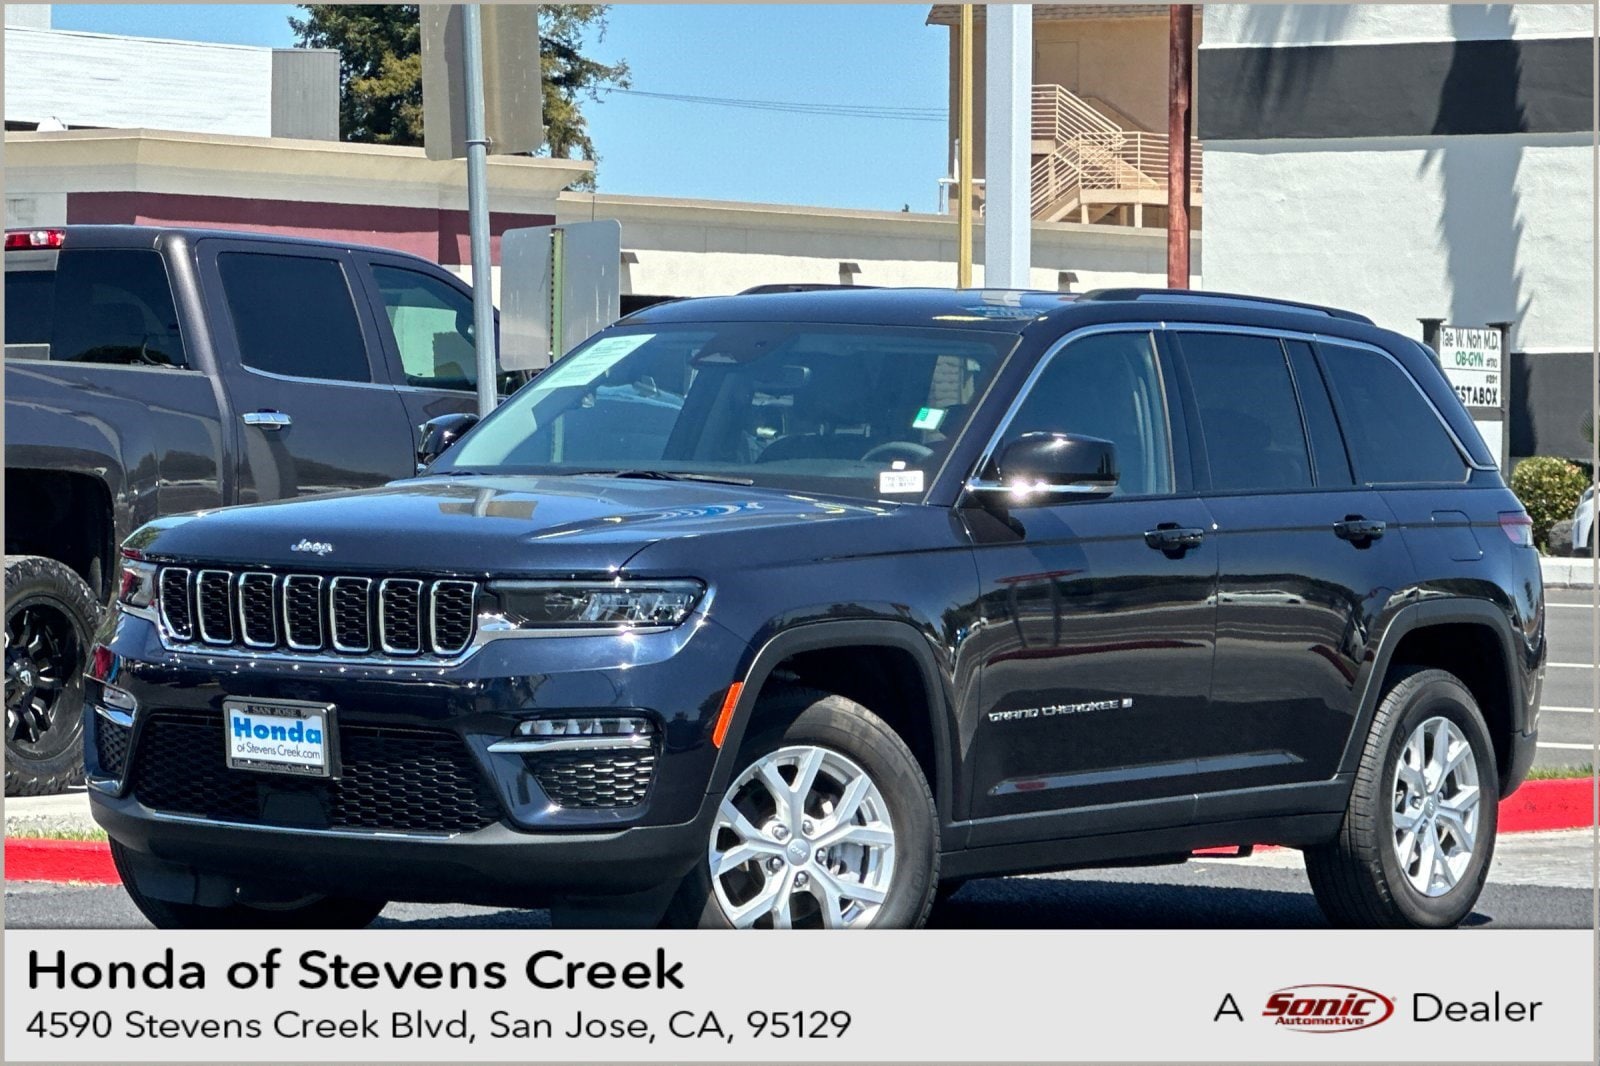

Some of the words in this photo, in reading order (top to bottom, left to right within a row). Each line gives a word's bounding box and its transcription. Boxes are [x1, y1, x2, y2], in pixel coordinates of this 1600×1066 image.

[1442, 328, 1454, 347] Tae
[1455, 329, 1465, 348] W.
[1466, 330, 1482, 349] Noh
[1455, 351, 1484, 367] OB-GYN
[290, 538, 333, 556] Jeep
[252, 705, 271, 714] SAN
[274, 708, 298, 717] JOSE
[988, 708, 1039, 722] GRAND
[1042, 700, 1119, 715] CHEROKEE
[233, 716, 322, 744] Honda
[237, 742, 245, 752] of
[246, 741, 277, 756] Stevens
[276, 744, 320, 759] Creek.com
